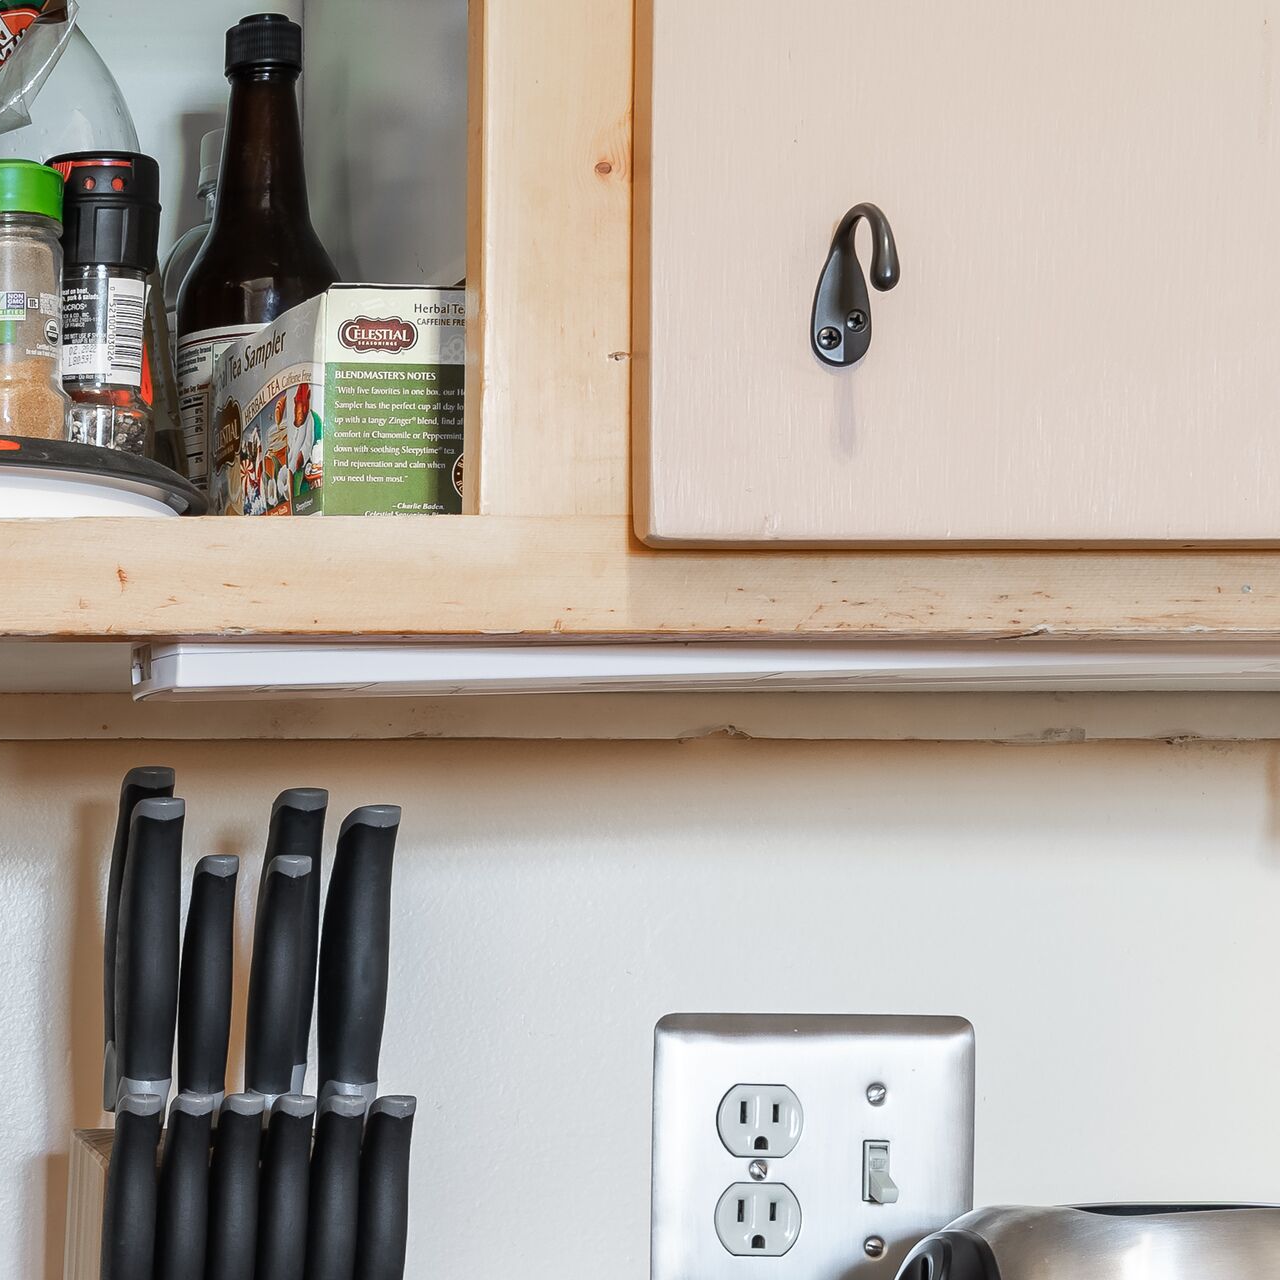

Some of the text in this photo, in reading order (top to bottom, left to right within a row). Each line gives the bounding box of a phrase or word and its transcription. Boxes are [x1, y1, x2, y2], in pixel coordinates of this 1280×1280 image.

[414, 304, 450, 313] Herbal
[417, 318, 450, 326] CAFFEINE
[345, 325, 410, 342] CELESTIAL
[244, 330, 287, 372] Sampler
[335, 371, 436, 380] BLENDMASTER'S NOTES
[357, 386, 369, 395] five
[371, 387, 400, 395] favorites
[402, 387, 409, 395] in
[244, 390, 266, 425] HERBAL
[267, 378, 280, 398] TEA
[335, 401, 364, 410] Sampler
[365, 401, 377, 409] has
[379, 401, 390, 409] the
[391, 402, 416, 412] perfect
[418, 404, 431, 412] cup
[443, 403, 456, 412] day
[345, 416, 360, 424] with
[368, 417, 387, 426] tangy
[417, 417, 439, 426] blend,
[441, 417, 456, 425] find
[334, 430, 361, 438] comfort
[362, 430, 370, 438] in
[371, 430, 411, 439] Chamomile
[333, 445, 352, 453] down
[353, 445, 368, 453] with
[370, 446, 400, 456] soothing
[350, 460, 393, 469] rejuvenation
[409, 461, 426, 469] calm
[427, 461, 446, 469] when
[332, 475, 346, 484] you
[366, 475, 384, 483] them
